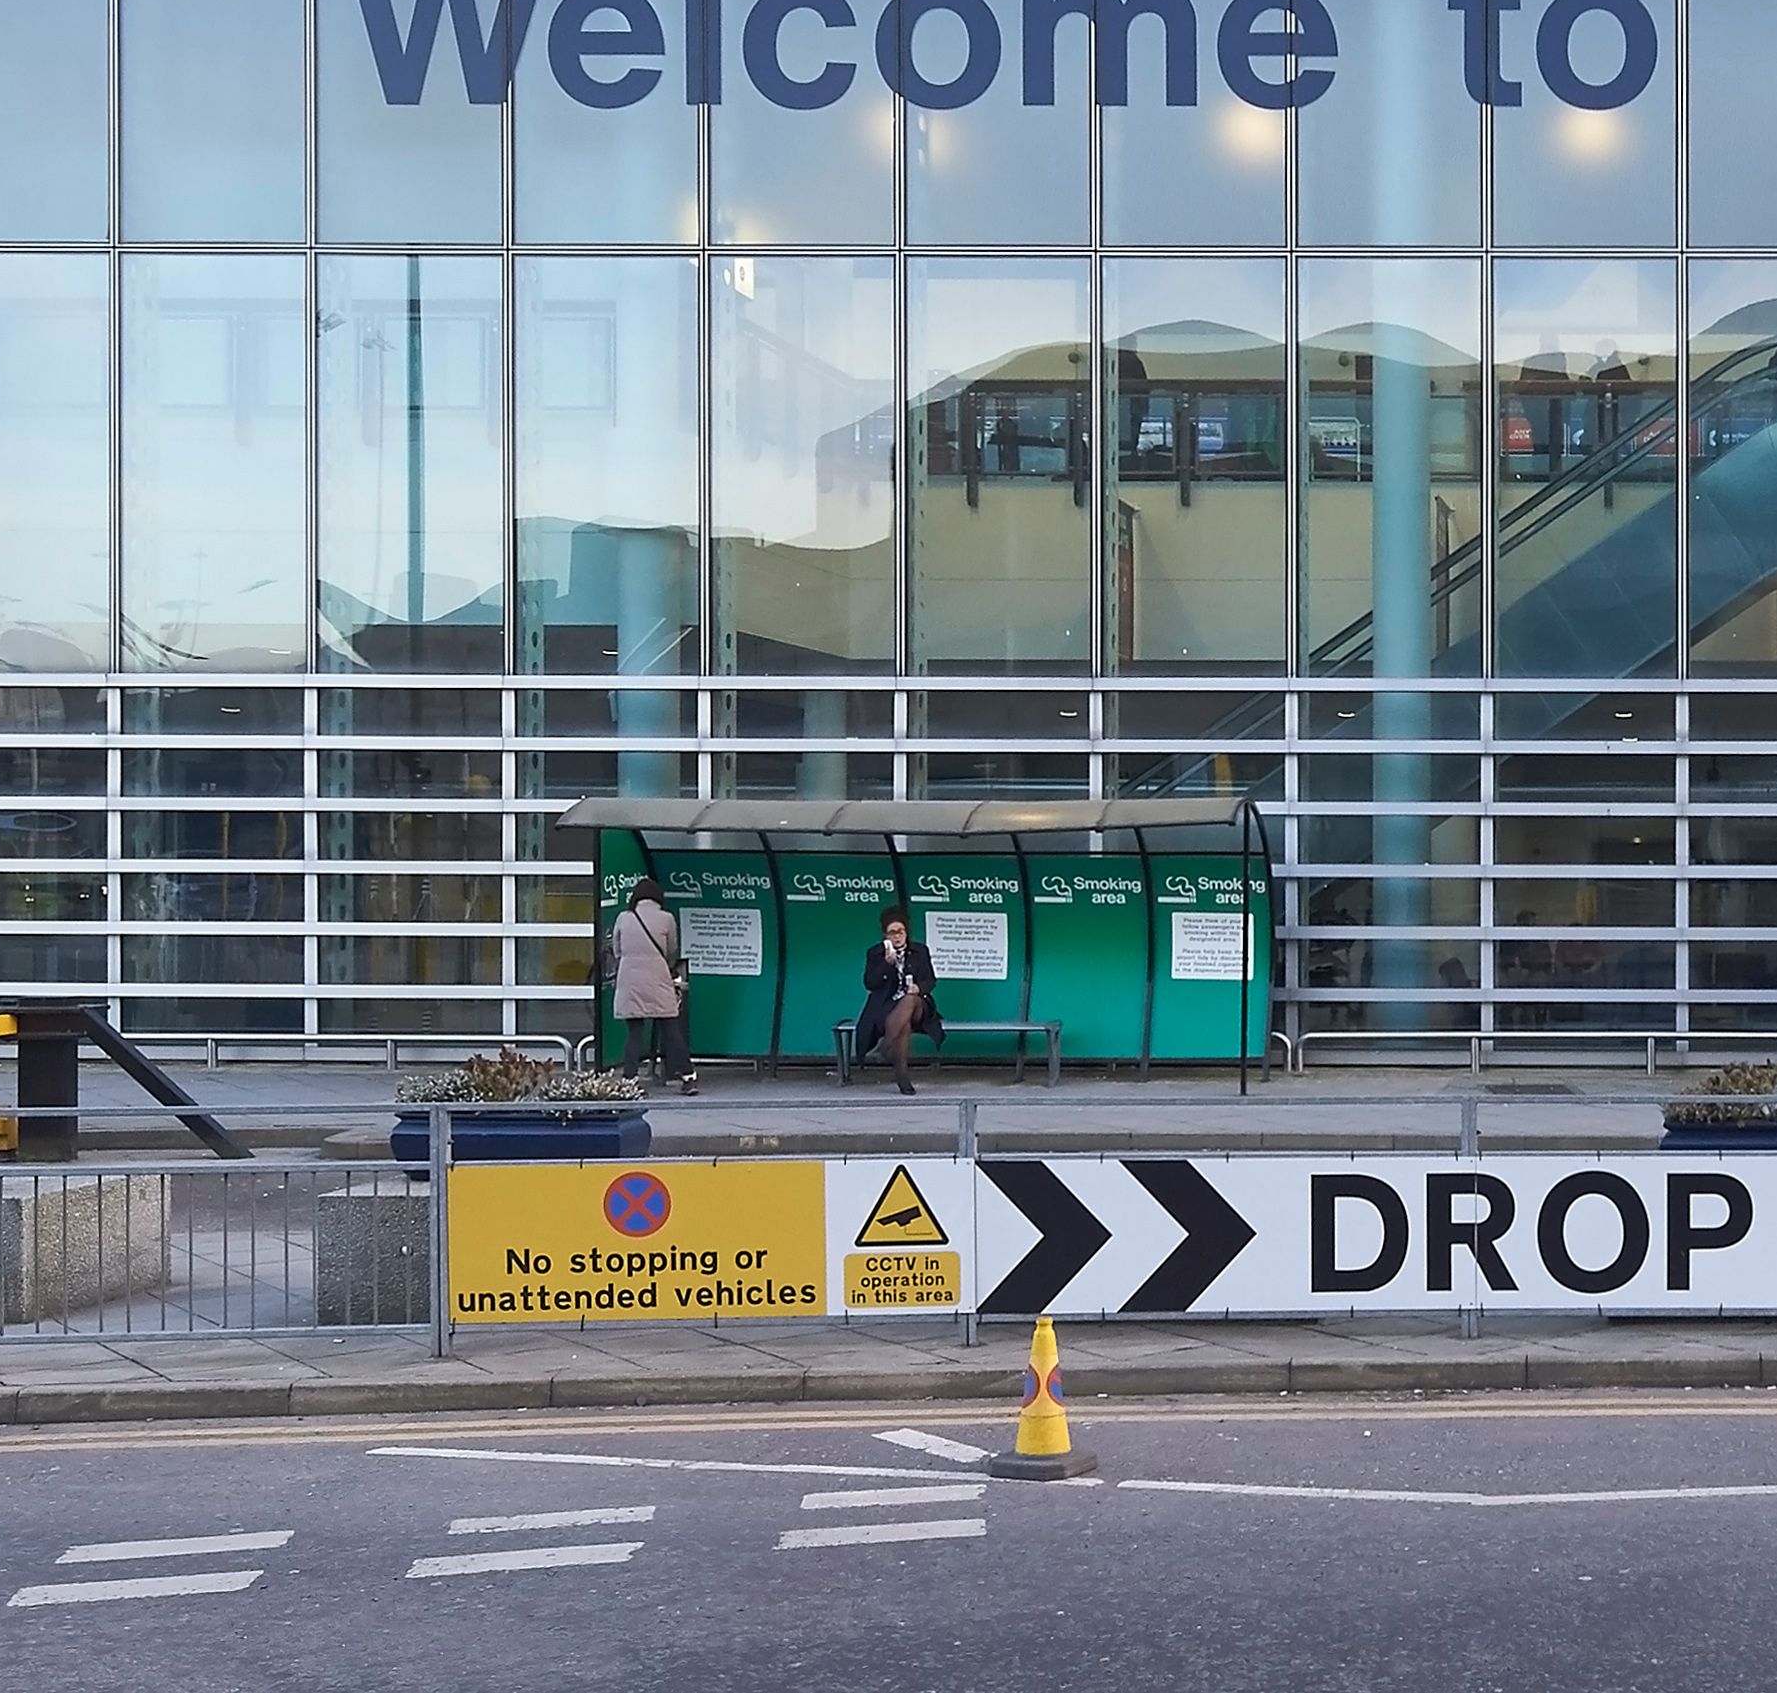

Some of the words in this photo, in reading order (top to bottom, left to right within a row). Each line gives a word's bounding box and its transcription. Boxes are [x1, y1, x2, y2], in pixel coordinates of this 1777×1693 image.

[701, 871, 771, 890] Smoking
[825, 874, 895, 892] Smoking
[949, 875, 1019, 893] Smoking
[1073, 875, 1142, 894] Smoking
[1197, 876, 1266, 893] Smokng
[721, 888, 756, 900] area
[844, 890, 879, 903] area
[968, 893, 1003, 904] area
[1091, 893, 1126, 905] area
[1310, 1169, 1754, 1294] DROP
[505, 1247, 552, 1276] No
[569, 1245, 719, 1278] stopping
[734, 1246, 768, 1270] or
[864, 1256, 917, 1273] CCTV
[923, 1256, 940, 1272] in
[859, 1272, 946, 1291] operation
[457, 1282, 658, 1314] unattended
[674, 1278, 817, 1307] vehicles
[851, 1288, 866, 1304] in
[872, 1287, 907, 1304] this
[914, 1289, 954, 1303] area
